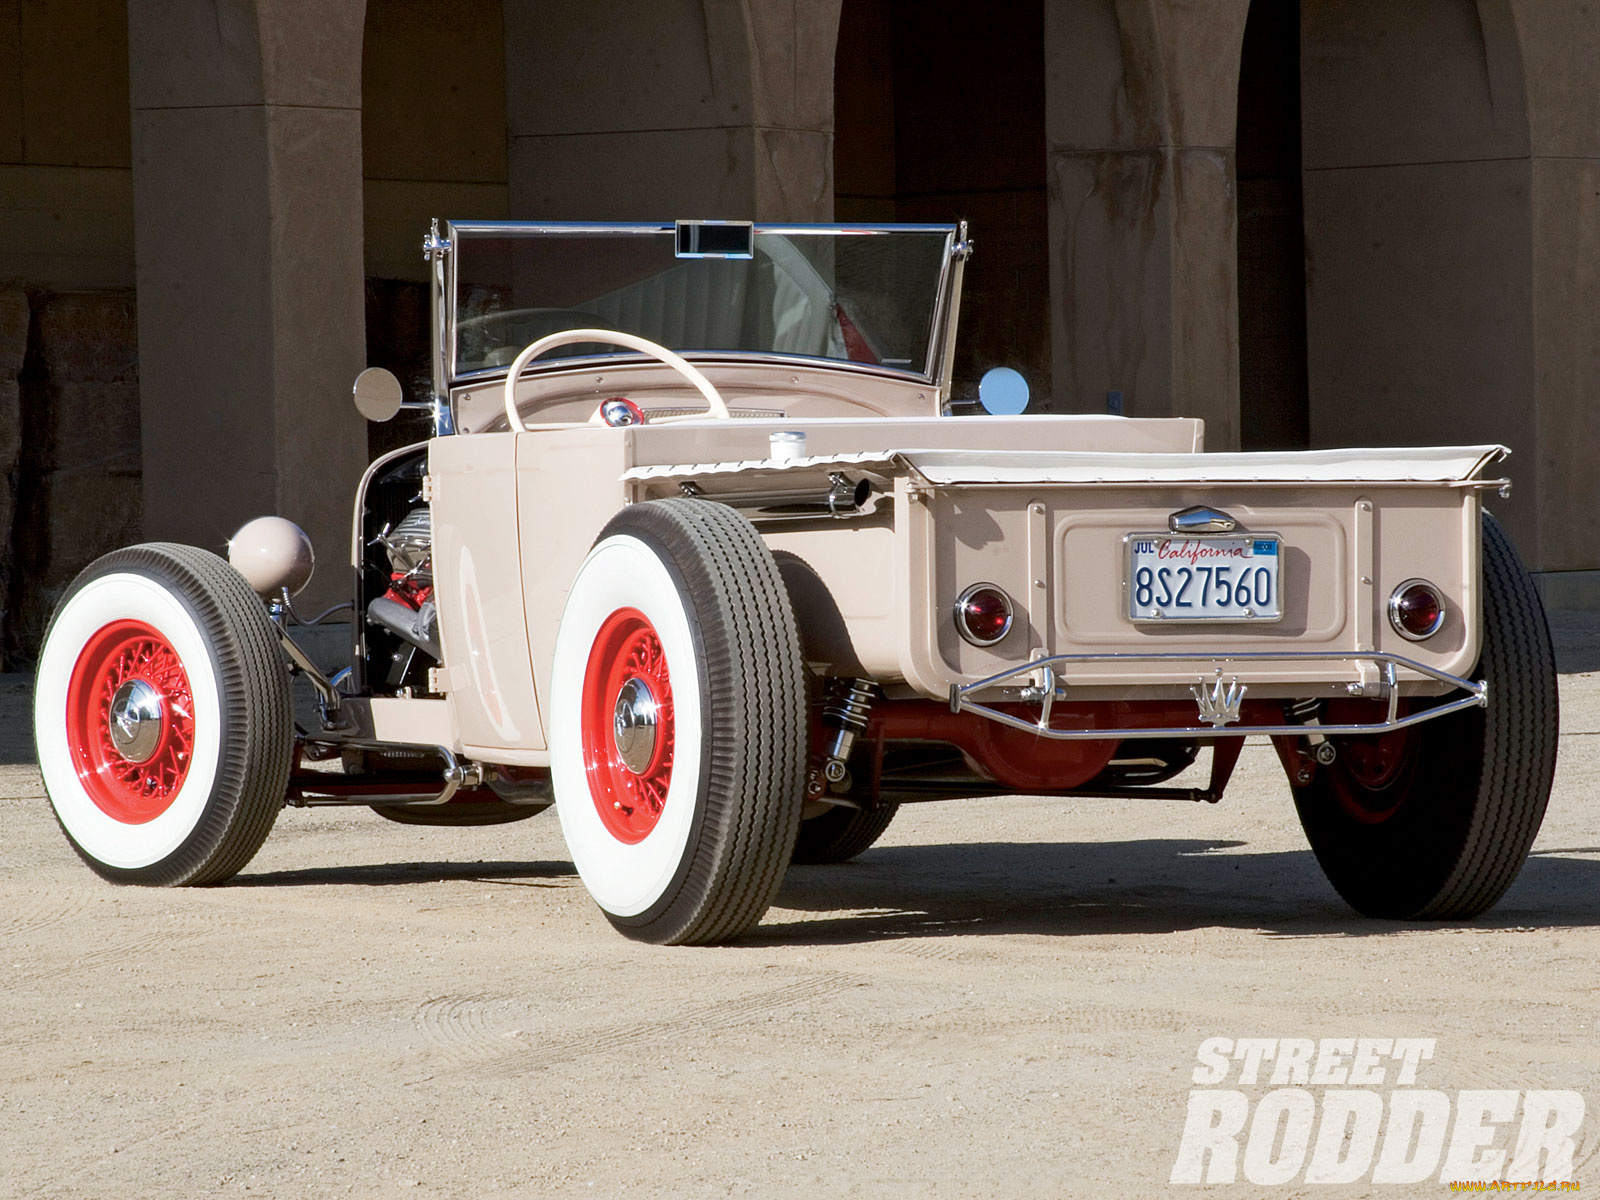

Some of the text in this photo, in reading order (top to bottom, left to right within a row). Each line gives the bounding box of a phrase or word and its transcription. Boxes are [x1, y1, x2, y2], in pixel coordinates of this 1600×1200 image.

[1134, 542, 1154, 554] JUL
[1158, 539, 1253, 565] California
[1136, 566, 1271, 607] 8S27560
